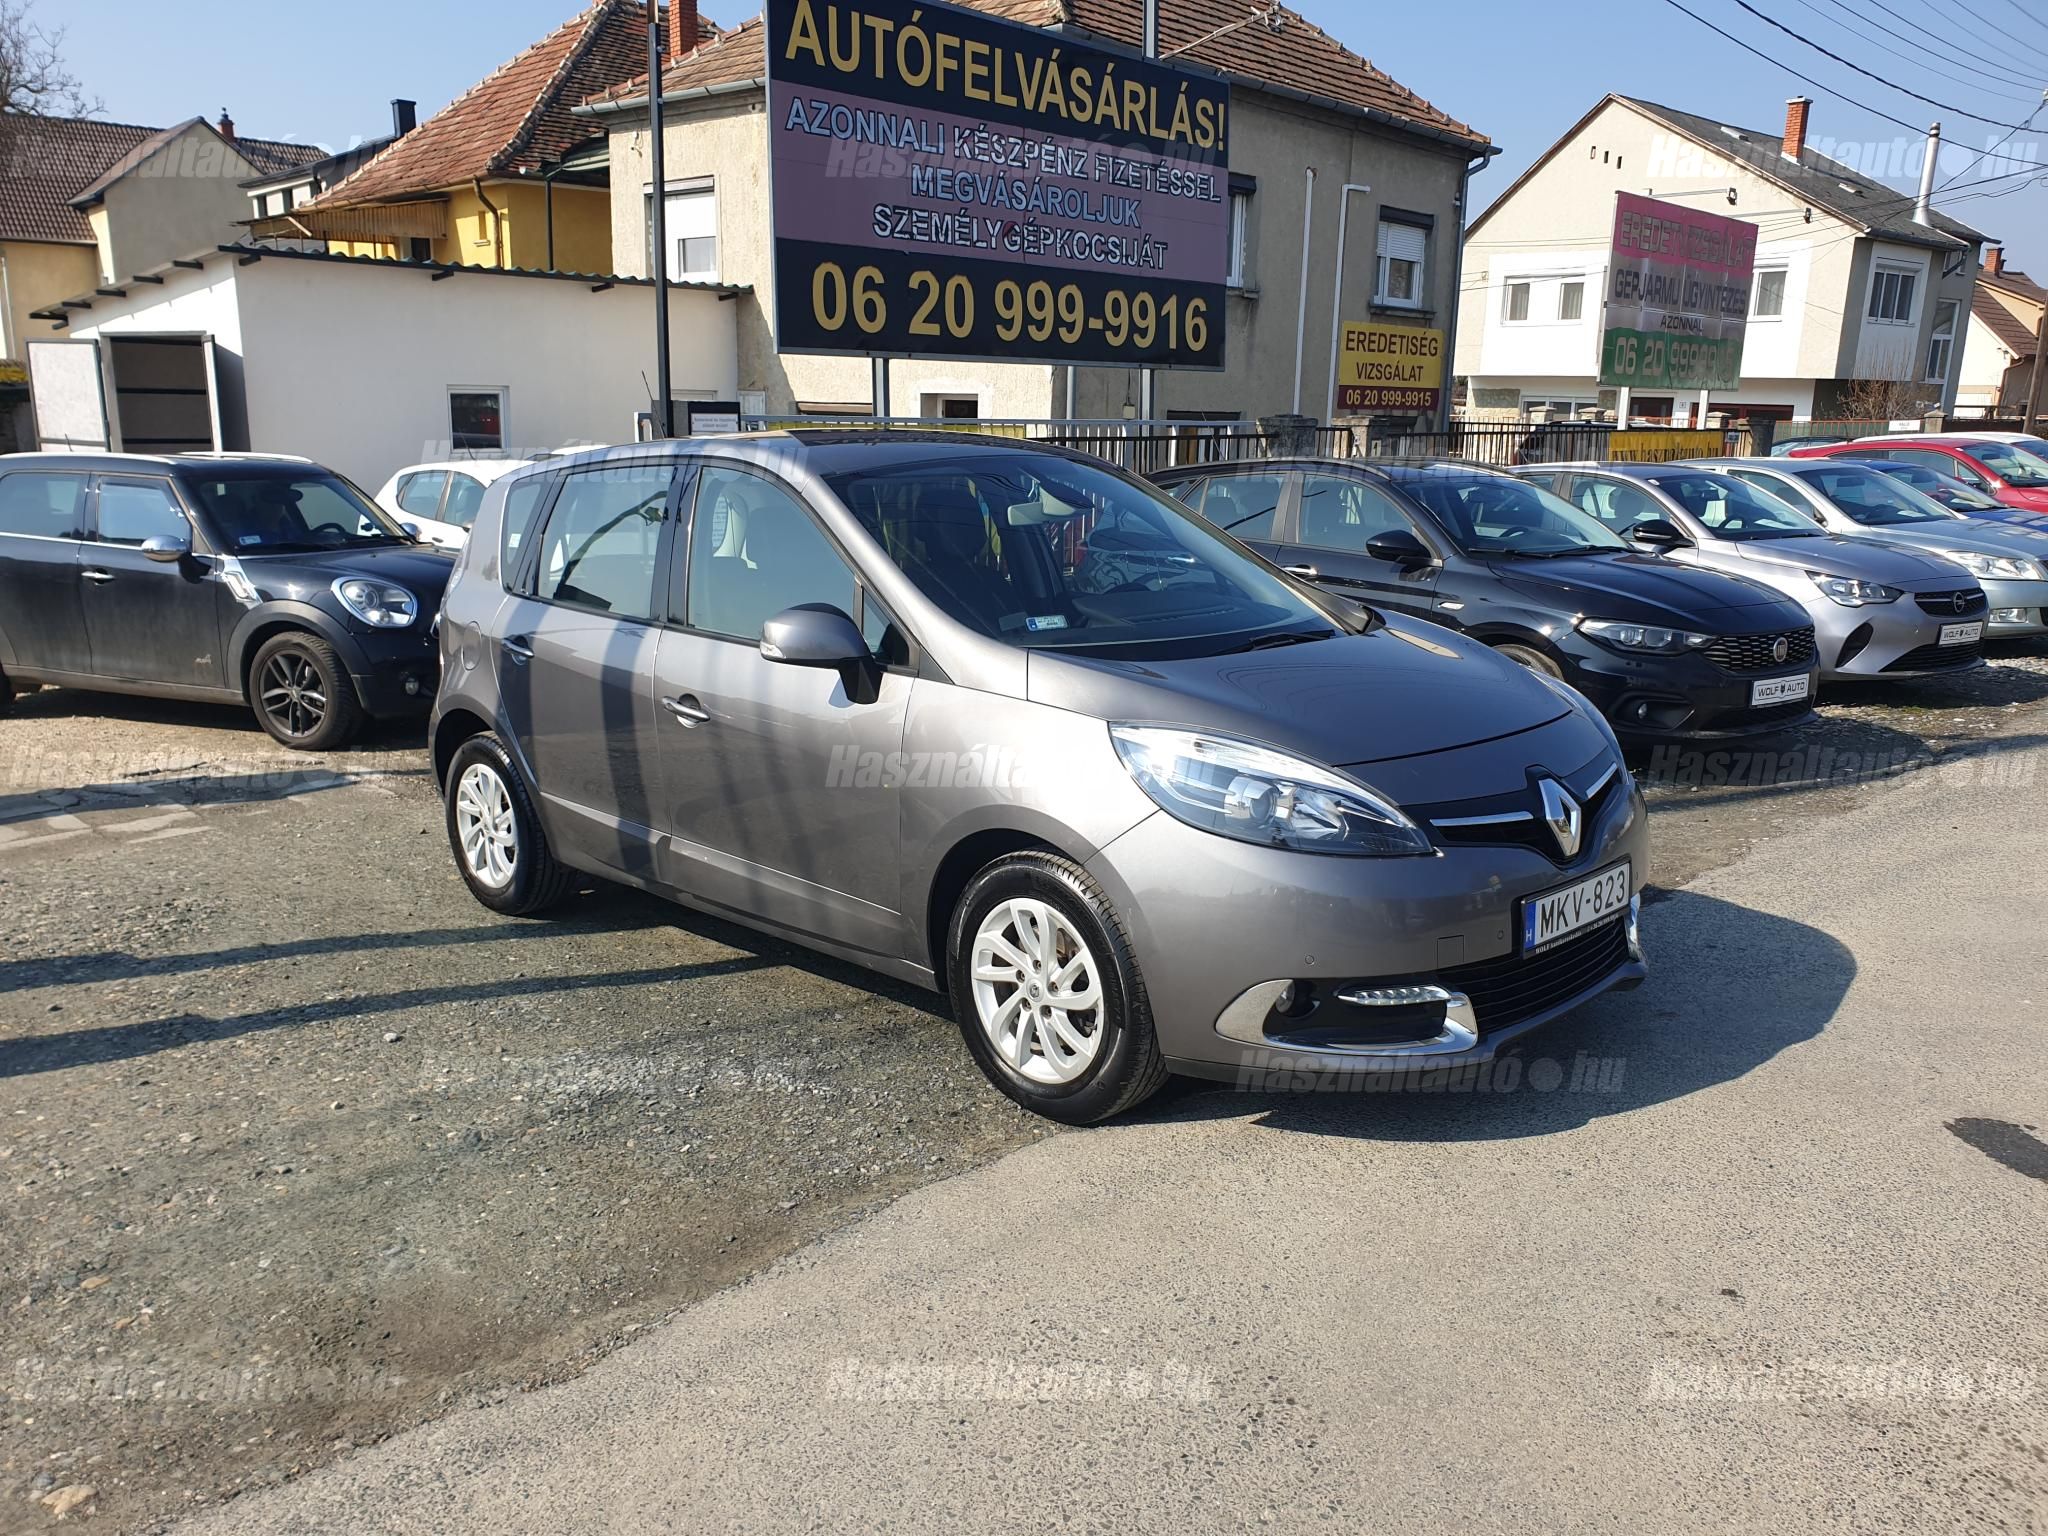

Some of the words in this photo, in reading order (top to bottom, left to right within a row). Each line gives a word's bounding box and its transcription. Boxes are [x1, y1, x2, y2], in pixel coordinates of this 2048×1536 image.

[785, 3, 1226, 151] AUTÓFELVÁSÁRLÁS!
[785, 97, 944, 155] AZONNALI
[953, 125, 1088, 180] KÉSZPÉNZ
[1095, 155, 1222, 203] FIZETÉSSEL
[911, 162, 1142, 229] MEGVÁSÁROLJUK
[873, 203, 1168, 270] SZEMÉLYGÉPKOCSIJÁT
[812, 261, 887, 334] 06
[907, 270, 975, 338] 20
[994, 279, 1207, 352] 999-9916
[1346, 330, 1438, 357] EREDETISÉG
[1356, 360, 1423, 382] VIZSGÁLAT
[1615, 337, 1637, 375] 06
[1642, 339, 1665, 376] 20
[1346, 390, 1361, 405] 06
[1364, 390, 1378, 405] 20
[1382, 391, 1431, 406] 999-9915
[1758, 686, 1779, 697] WOLF
[1787, 682, 1805, 693] AUTO
[1525, 929, 1532, 942] H
[1540, 870, 1625, 938] MKV-823
